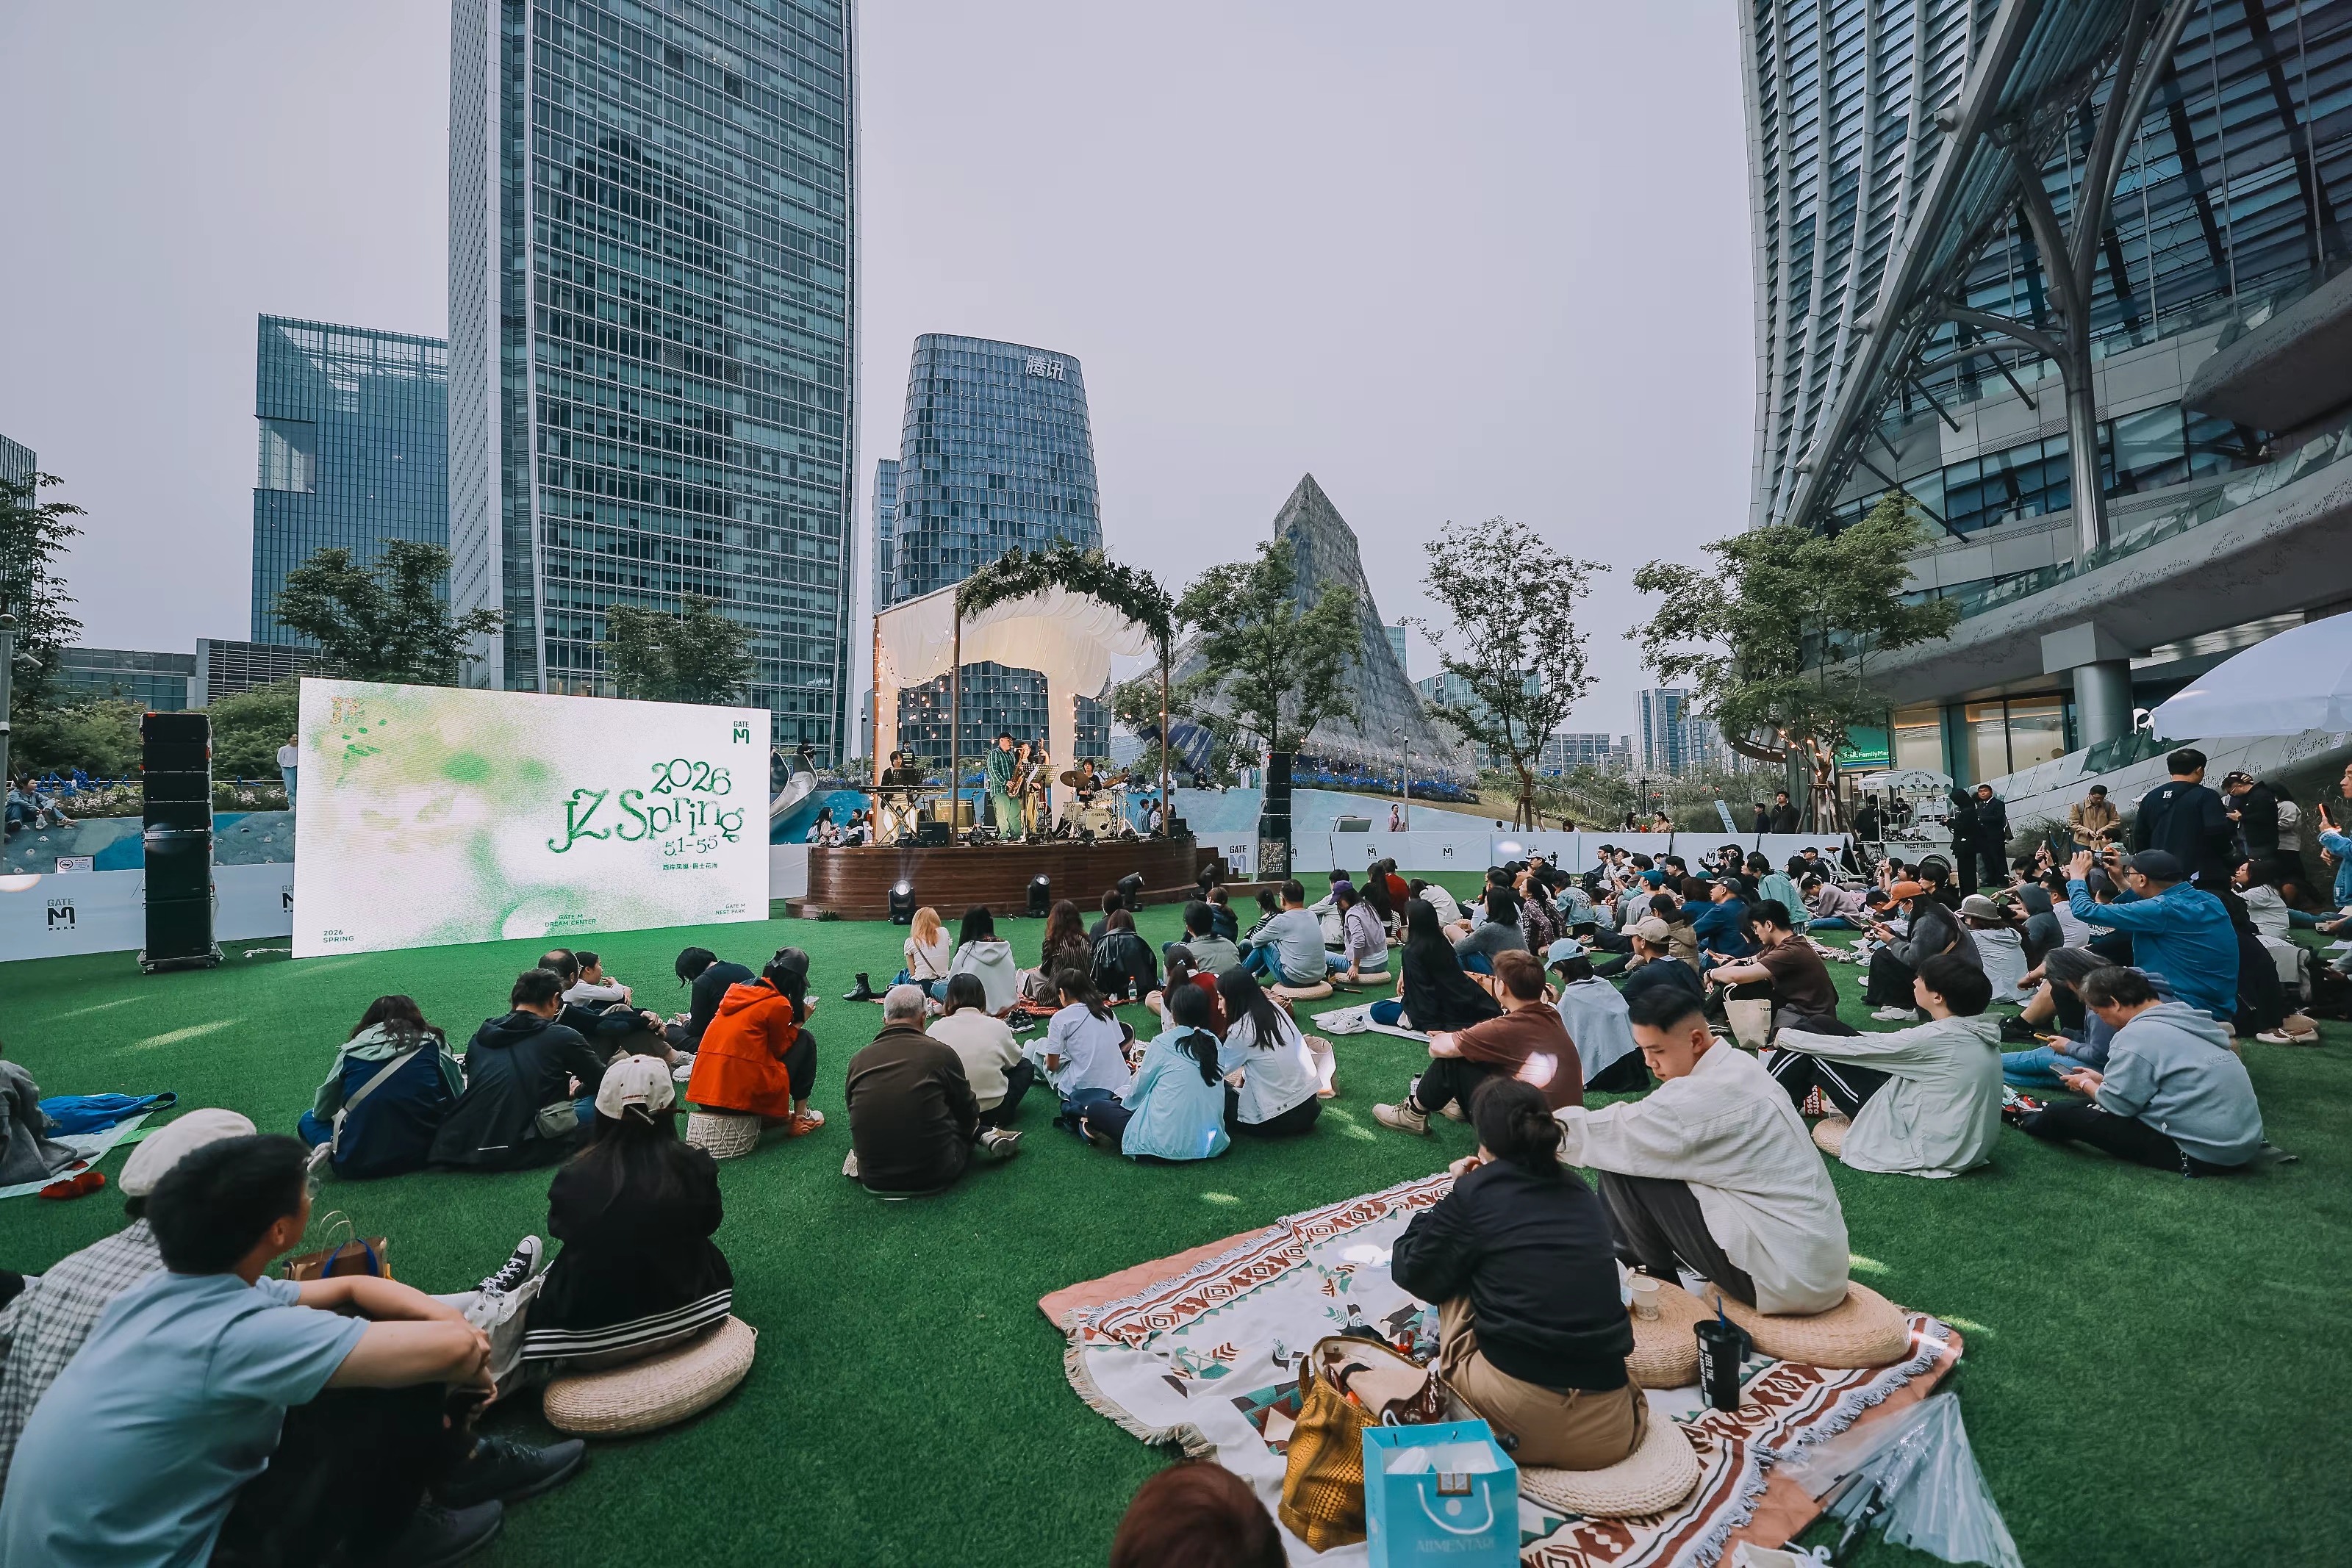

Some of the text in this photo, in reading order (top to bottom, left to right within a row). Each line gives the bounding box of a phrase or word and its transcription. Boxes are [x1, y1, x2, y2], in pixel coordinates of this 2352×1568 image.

[1025, 354, 1064, 381] 腾讯
[733, 720, 750, 728] GATE
[733, 728, 750, 744] M
[651, 758, 732, 795] 2026
[1924, 773, 1935, 782] PARK
[616, 789, 745, 843] Spring
[1229, 844, 1247, 854] GATE
[47, 898, 75, 907] GATE
[47, 906, 76, 926] M
[323, 935, 354, 943] SPRING
[1704, 1352, 1714, 1381] FEEL THE
